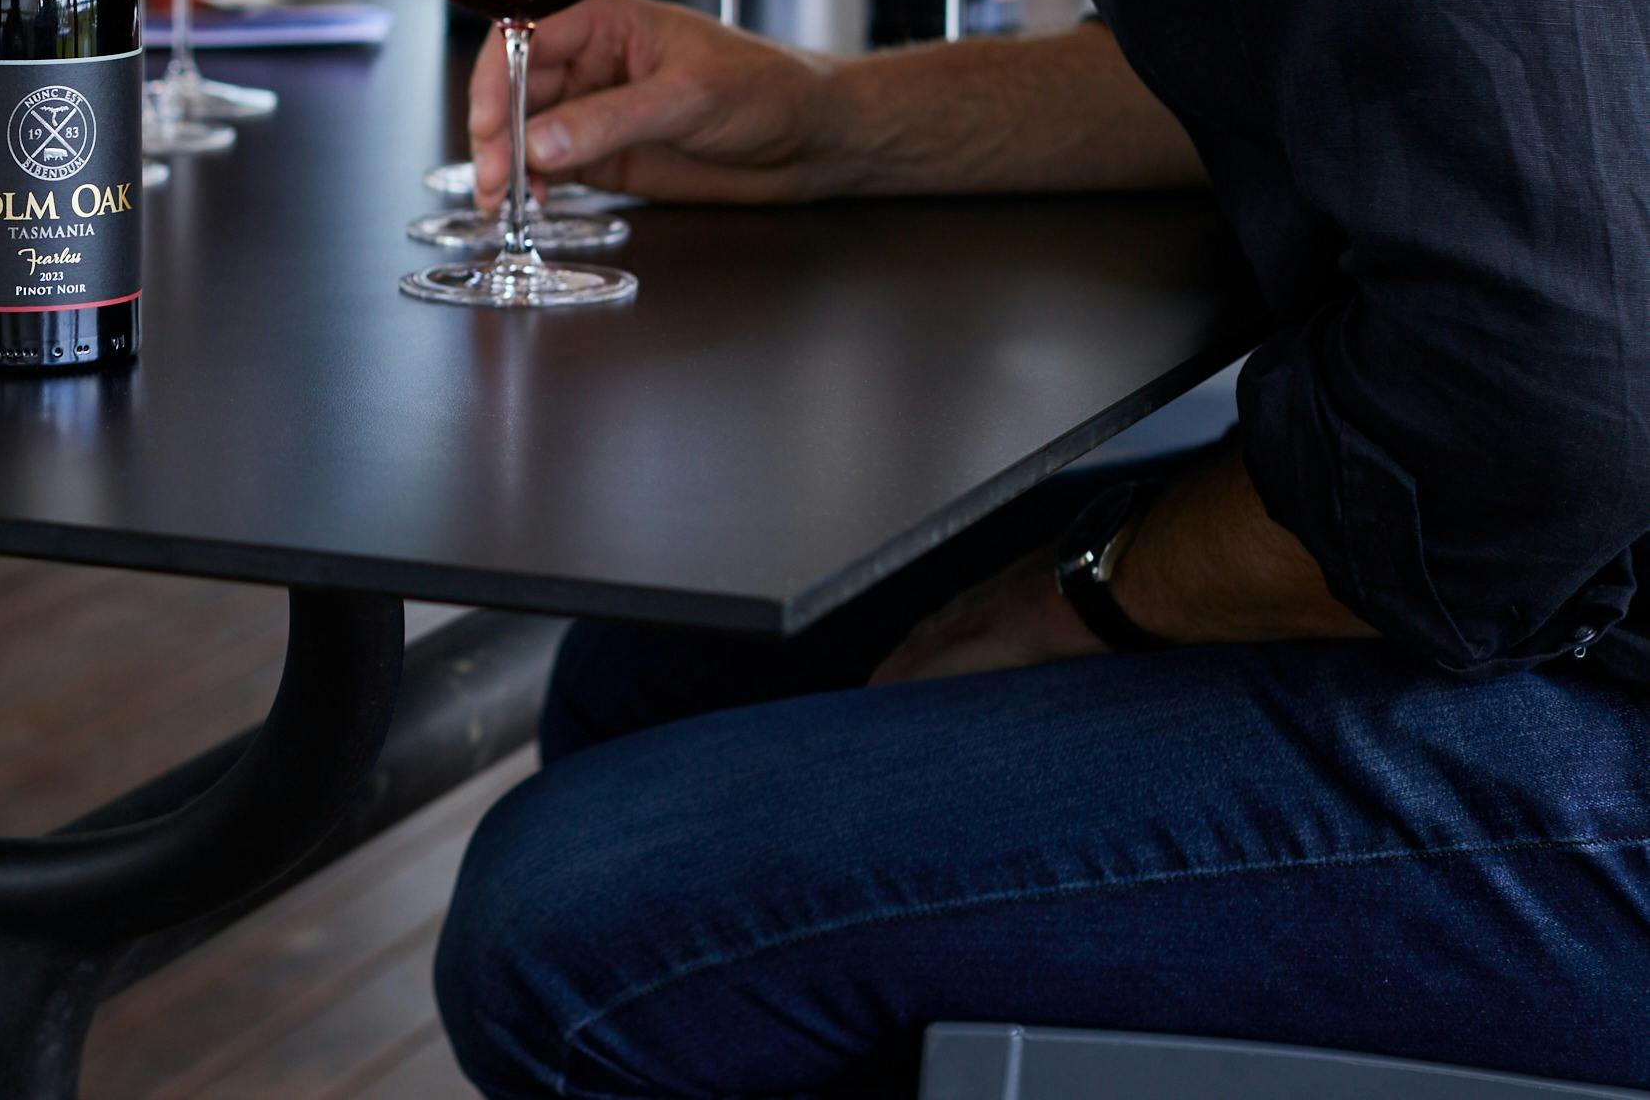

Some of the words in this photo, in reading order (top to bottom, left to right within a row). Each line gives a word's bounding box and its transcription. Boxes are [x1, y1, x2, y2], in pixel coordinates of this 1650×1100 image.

[24, 88, 59, 108] NUNC
[64, 90, 84, 106] EST
[28, 128, 42, 140] 19
[65, 126, 79, 139] 83
[22, 156, 86, 178] BIBENDUM
[71, 182, 134, 218] OAK
[7, 223, 96, 240] TASMANIA
[17, 247, 82, 276] Fearless
[39, 271, 64, 282] 2023
[15, 285, 53, 296] PINOT
[57, 283, 87, 295] NOIR
